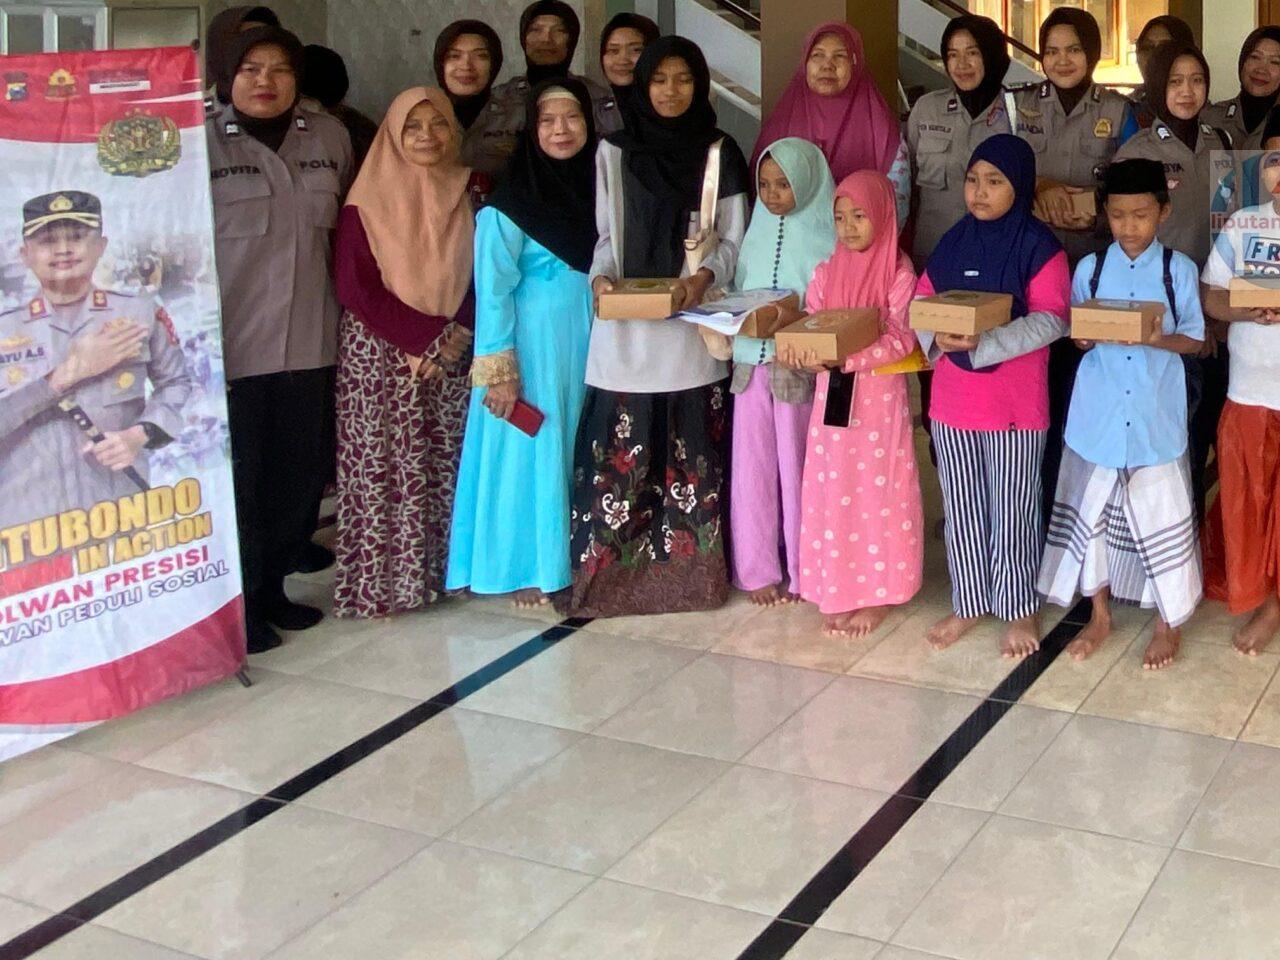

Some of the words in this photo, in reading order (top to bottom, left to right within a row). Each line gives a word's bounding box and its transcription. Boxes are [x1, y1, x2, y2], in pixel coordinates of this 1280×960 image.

[0, 477, 202, 566] TUBONDO
[77, 543, 110, 575] IN
[112, 511, 214, 565] ACTION
[58, 585, 143, 628] PEDULI
[149, 559, 230, 598] SOSIAL
[104, 545, 210, 592] PRESISI
